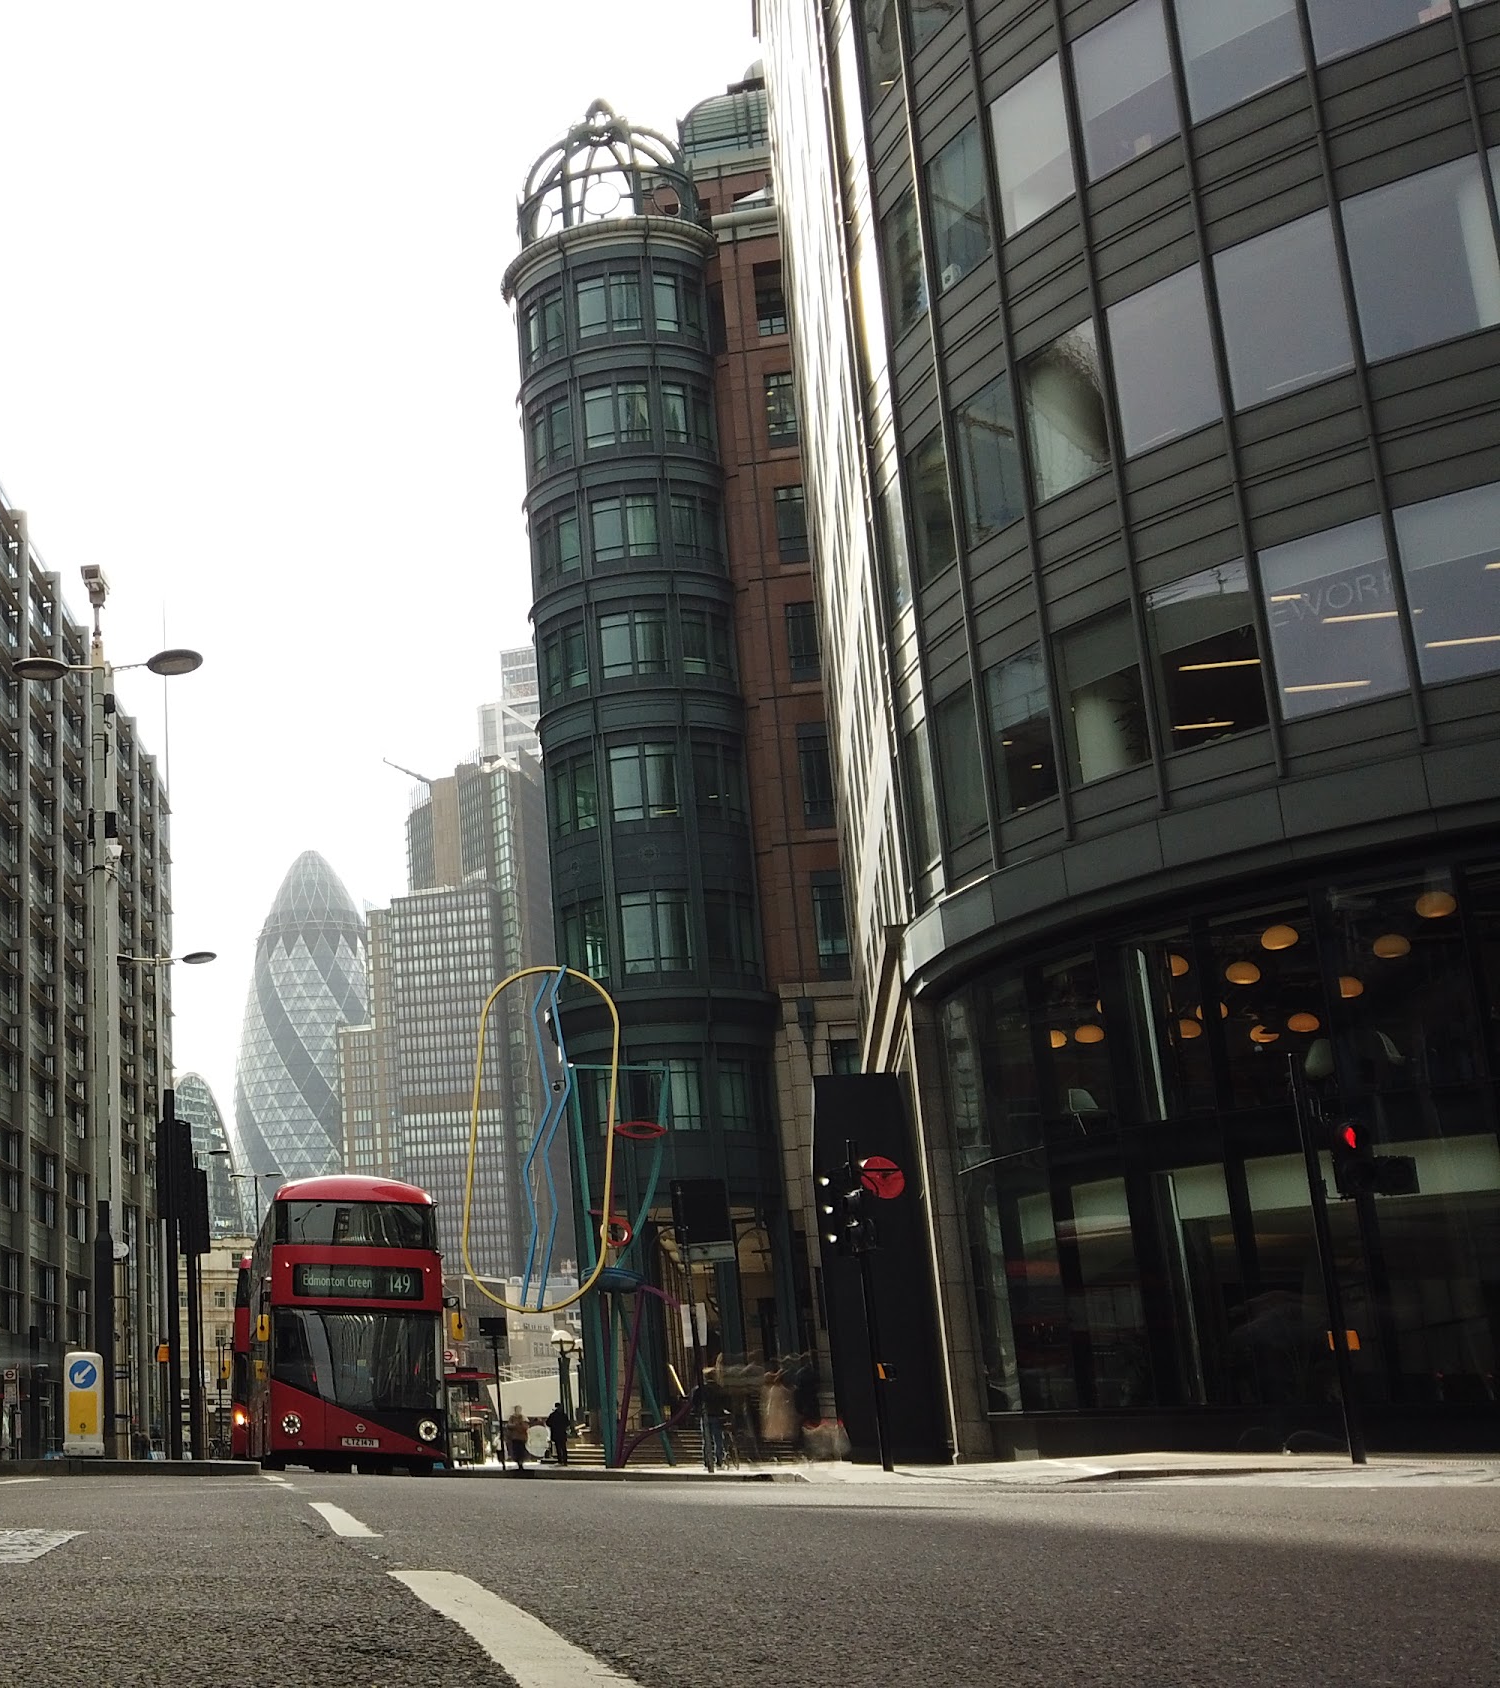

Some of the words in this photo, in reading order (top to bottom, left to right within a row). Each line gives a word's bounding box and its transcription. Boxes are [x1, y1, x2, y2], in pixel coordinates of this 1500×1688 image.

[303, 1273, 345, 1287] Edmonton
[347, 1275, 372, 1289] Green
[390, 1274, 411, 1293] 149
